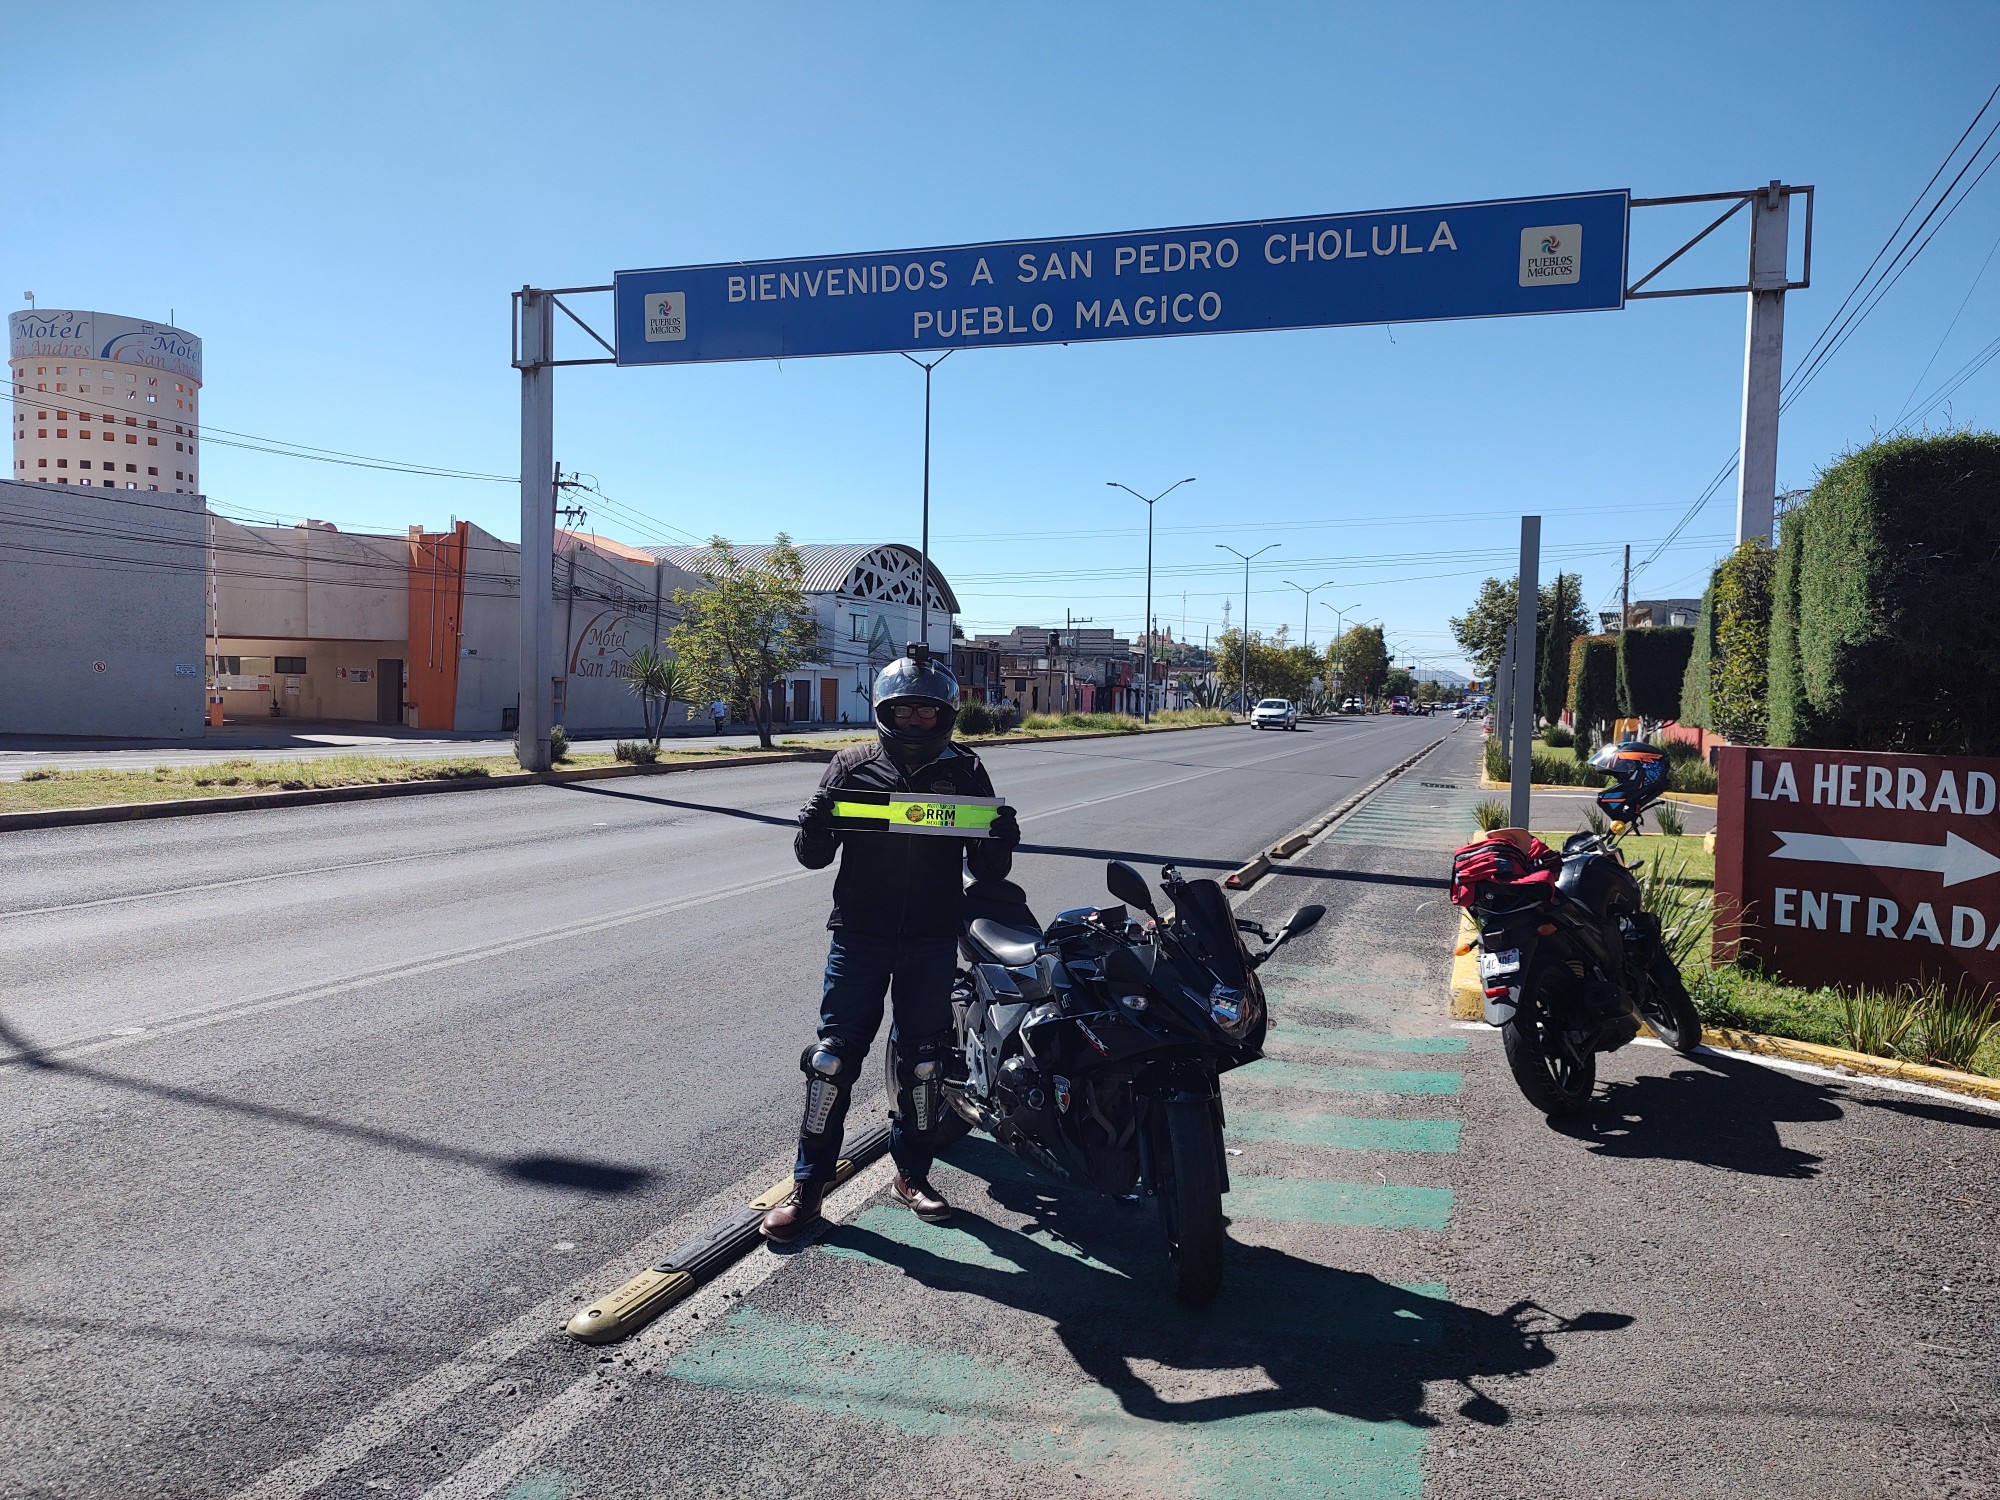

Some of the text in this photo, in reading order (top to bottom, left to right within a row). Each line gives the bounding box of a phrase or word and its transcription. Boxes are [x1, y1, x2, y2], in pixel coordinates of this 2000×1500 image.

[728, 220, 1458, 303] BIENVENIDOS A SAN PEDRO CHOLULA
[913, 291, 1222, 339] PUEBLO MAGICO
[16, 321, 89, 340] Motel
[28, 339, 91, 358] Andres
[150, 336, 200, 364] Motel
[135, 349, 166, 369] San
[588, 628, 629, 647] Motel
[577, 658, 603, 678] San
[1751, 760, 2000, 816] LA HERRAD
[926, 808, 956, 821] RRM
